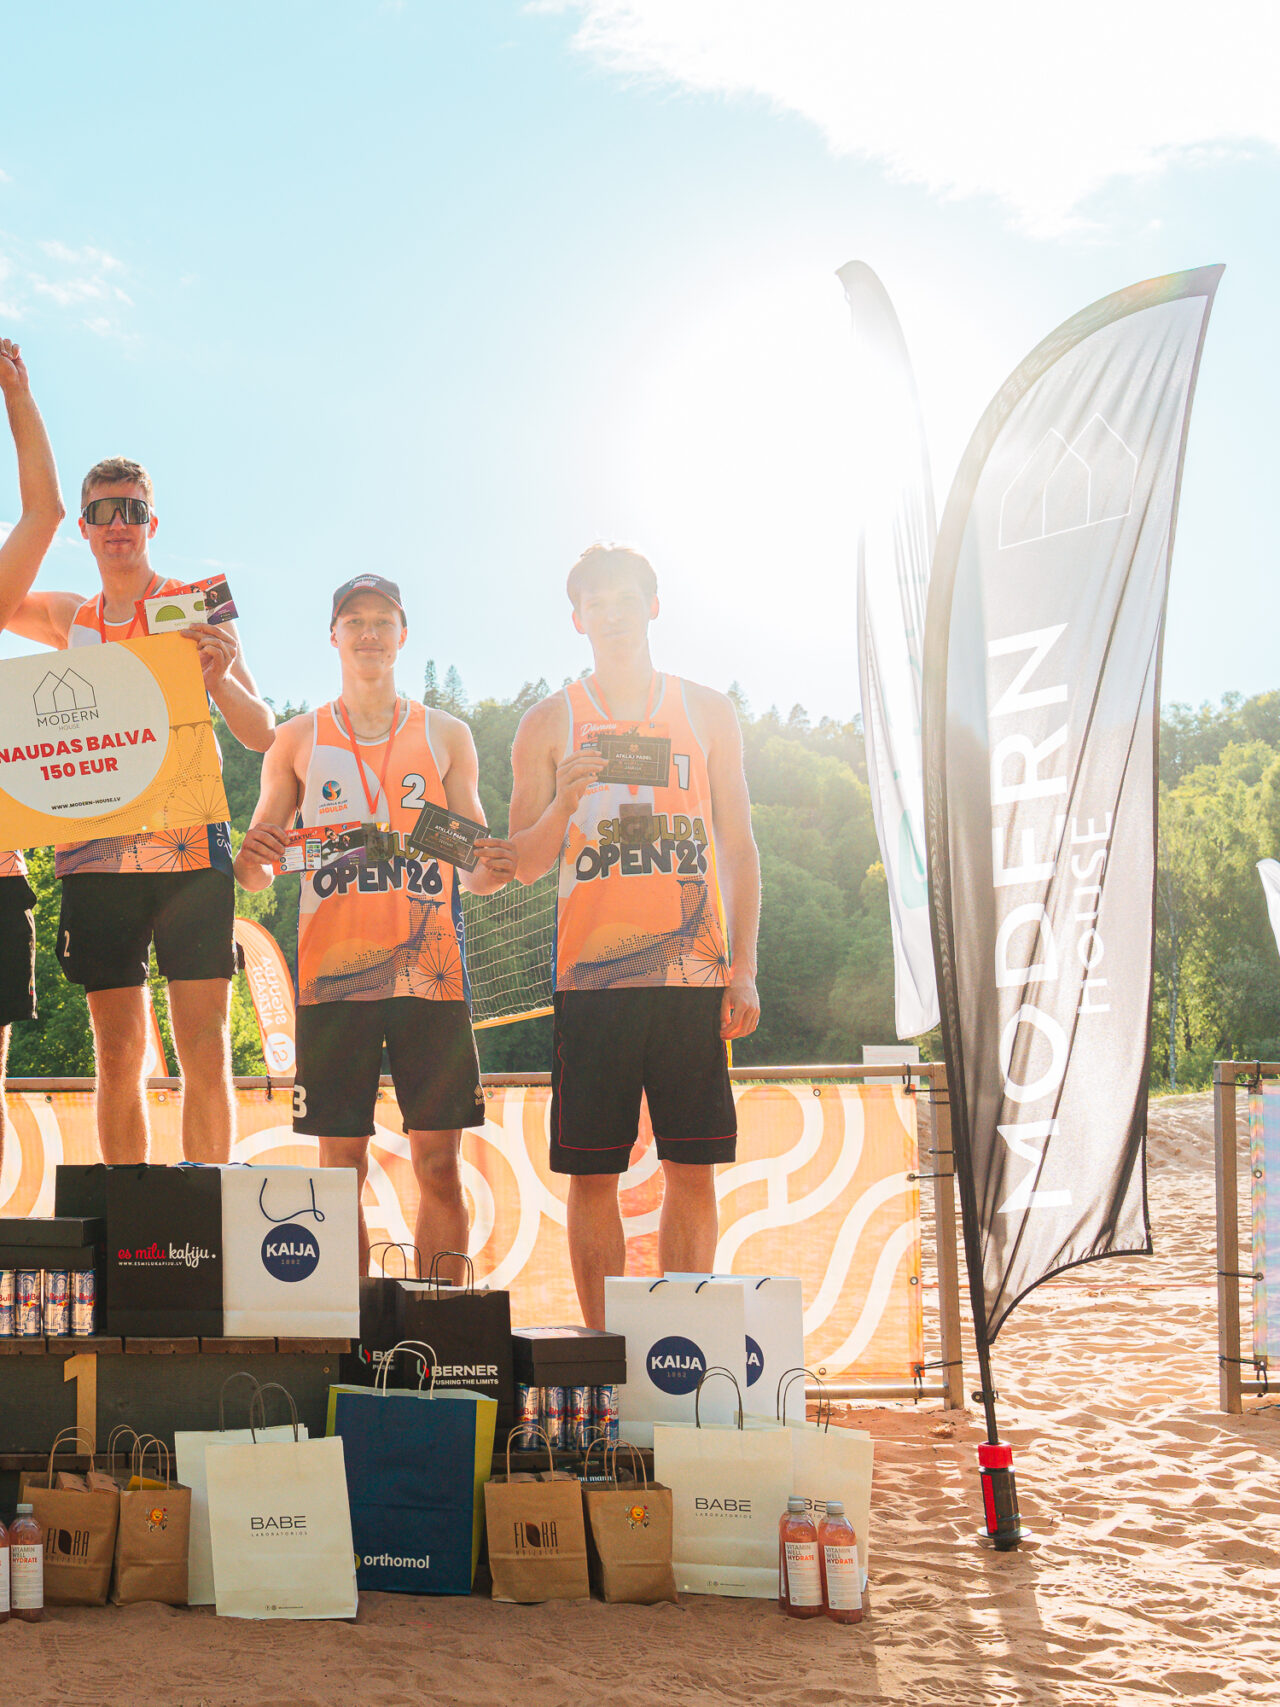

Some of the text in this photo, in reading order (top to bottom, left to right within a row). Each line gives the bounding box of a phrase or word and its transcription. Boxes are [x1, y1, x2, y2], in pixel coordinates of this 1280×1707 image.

[37, 709, 100, 728] MODERN
[86, 728, 157, 751] BALVA
[40, 757, 119, 781] 150 EUR
[673, 753, 690, 790] 1
[401, 773, 426, 809] 2
[51, 797, 121, 810] WWW.MODERN-HOUSE.LV
[988, 622, 1074, 1216] MODERN
[1072, 810, 1113, 1016] HOUSE
[118, 1249, 132, 1259] es
[266, 1242, 316, 1258] KAIJA
[431, 1365, 498, 1377] BERNER
[651, 1355, 703, 1371] KAIJA
[63, 1353, 97, 1455] 1
[364, 1553, 430, 1569] orthomol
